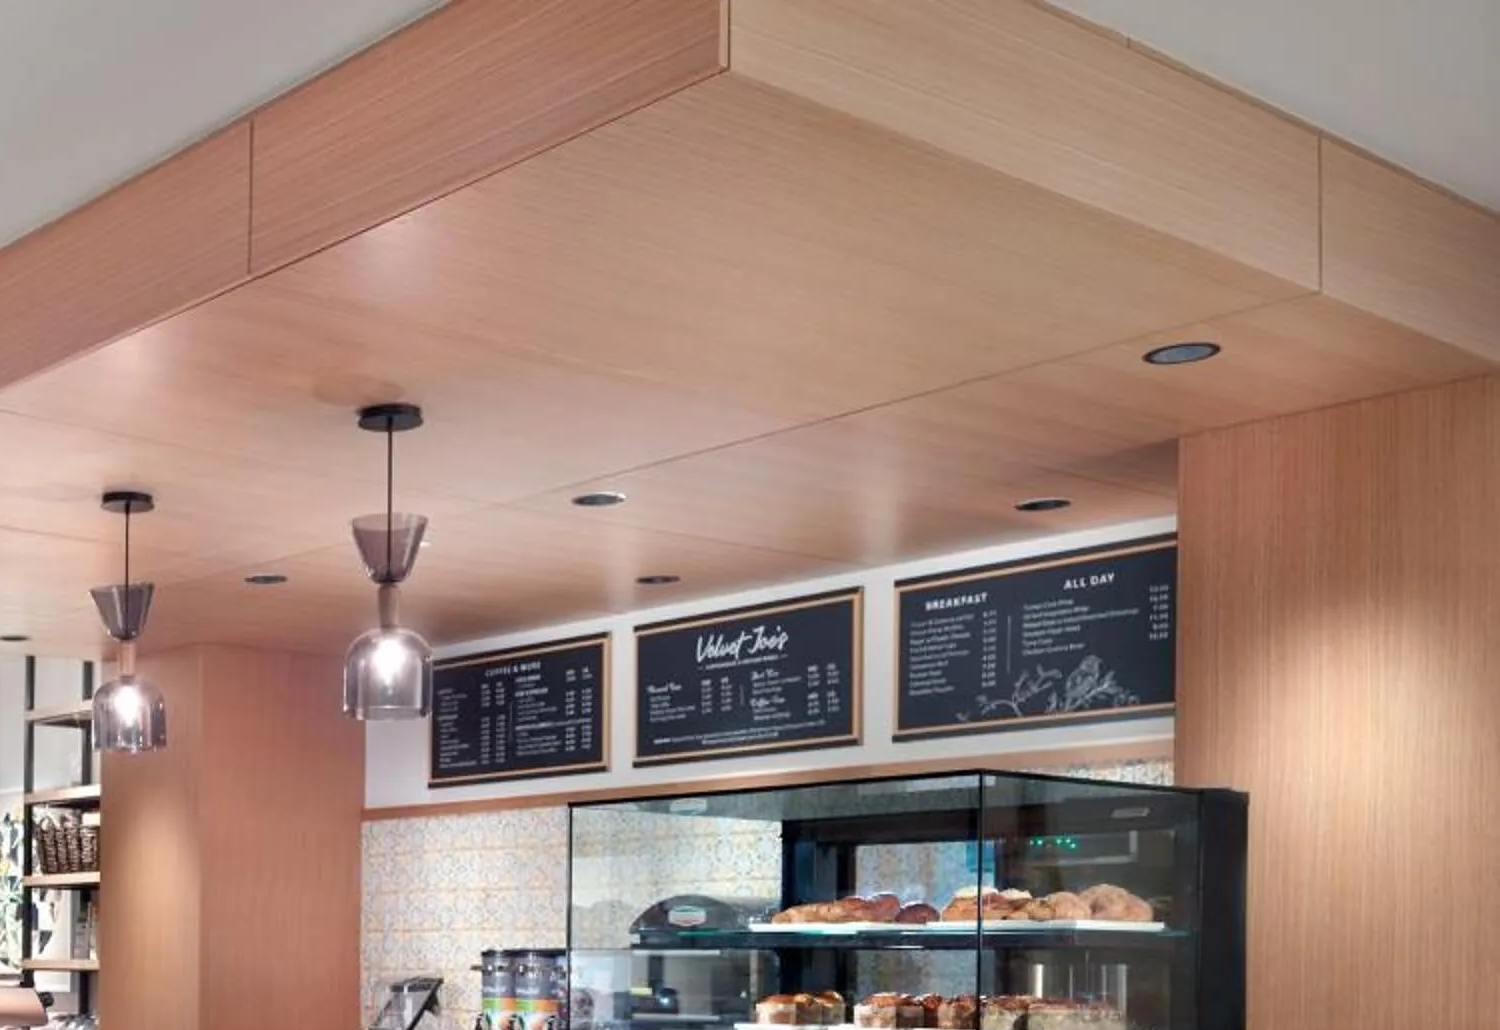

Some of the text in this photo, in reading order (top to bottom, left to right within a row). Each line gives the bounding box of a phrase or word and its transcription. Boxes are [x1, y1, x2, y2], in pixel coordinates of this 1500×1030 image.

[1063, 571, 1115, 590] ALL DAY
[924, 592, 988, 611] BREAKFAST
[696, 631, 753, 663] Velvet
[748, 625, 789, 654] Joe's
